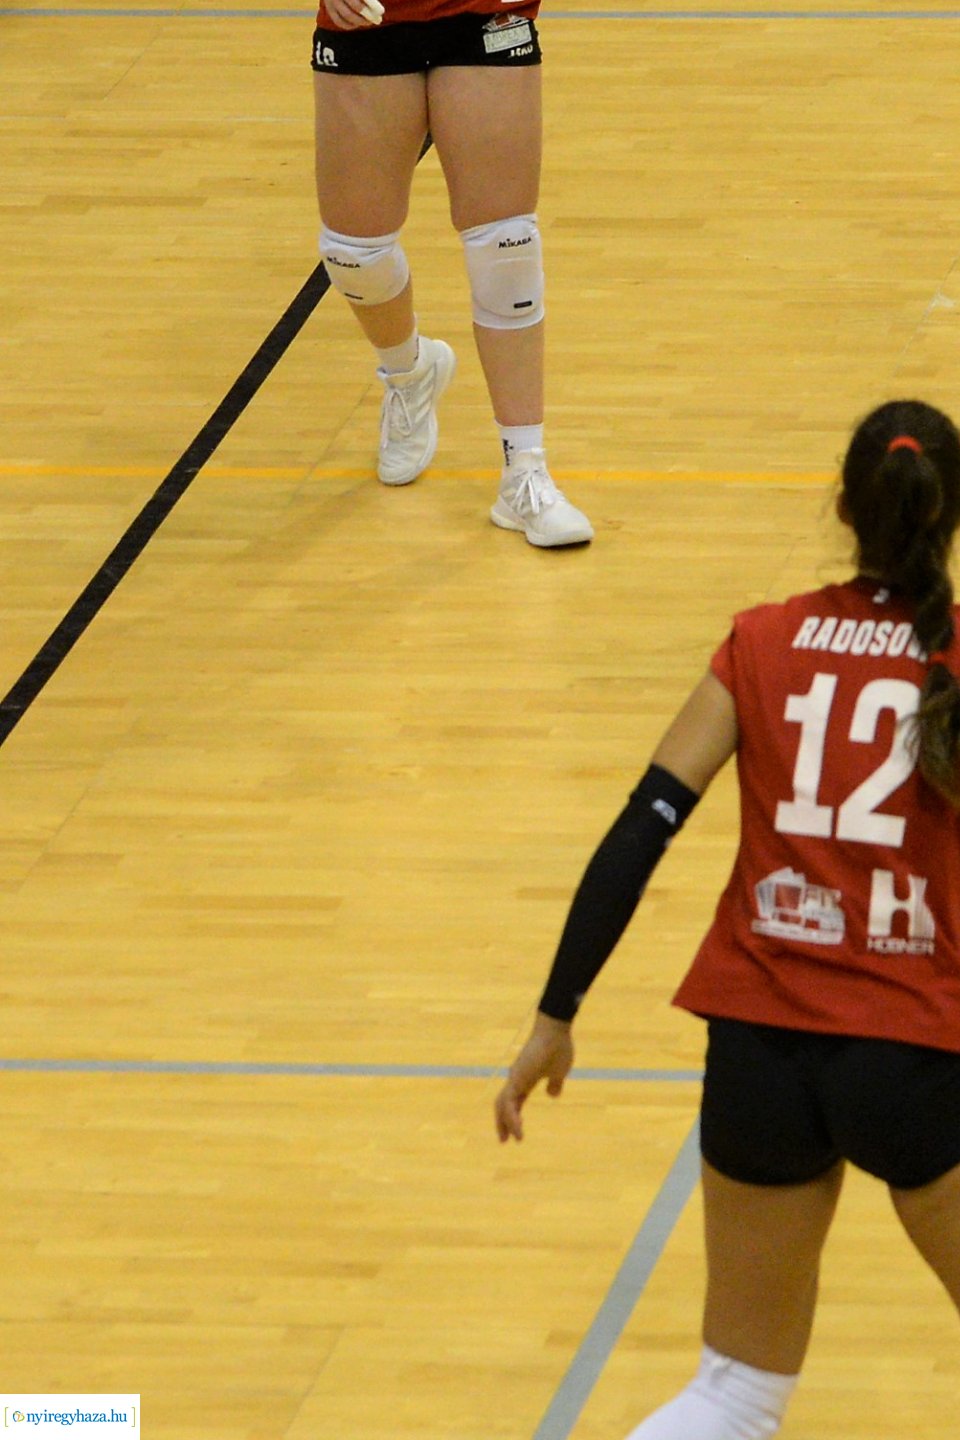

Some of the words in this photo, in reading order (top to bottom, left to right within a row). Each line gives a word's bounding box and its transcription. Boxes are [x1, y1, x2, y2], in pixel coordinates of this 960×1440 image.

[499, 236, 532, 249] MIKASA
[326, 257, 361, 270] MIKASA
[774, 671, 921, 849] 12
